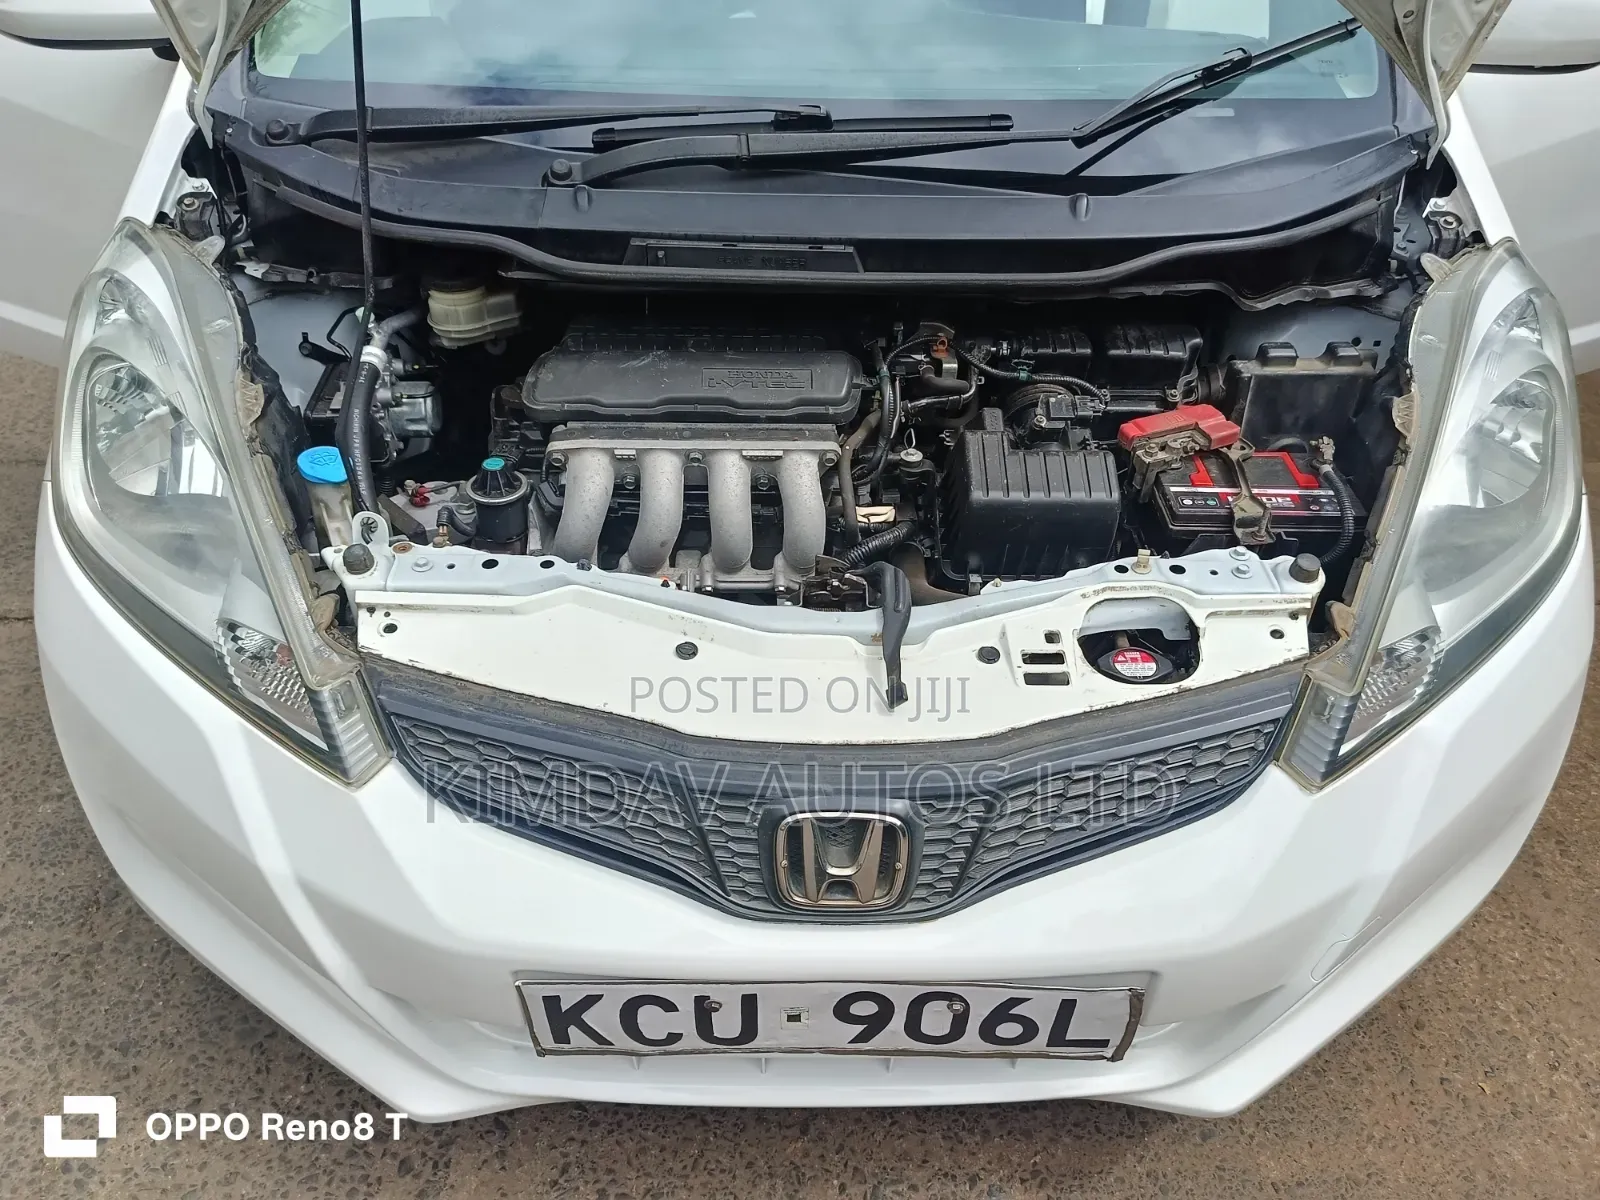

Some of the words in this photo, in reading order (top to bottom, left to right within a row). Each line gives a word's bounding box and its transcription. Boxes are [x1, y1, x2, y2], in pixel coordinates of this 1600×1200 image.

[727, 370, 798, 379] HONDA
[539, 992, 759, 1047] KCU
[832, 990, 1111, 1049] 906L
